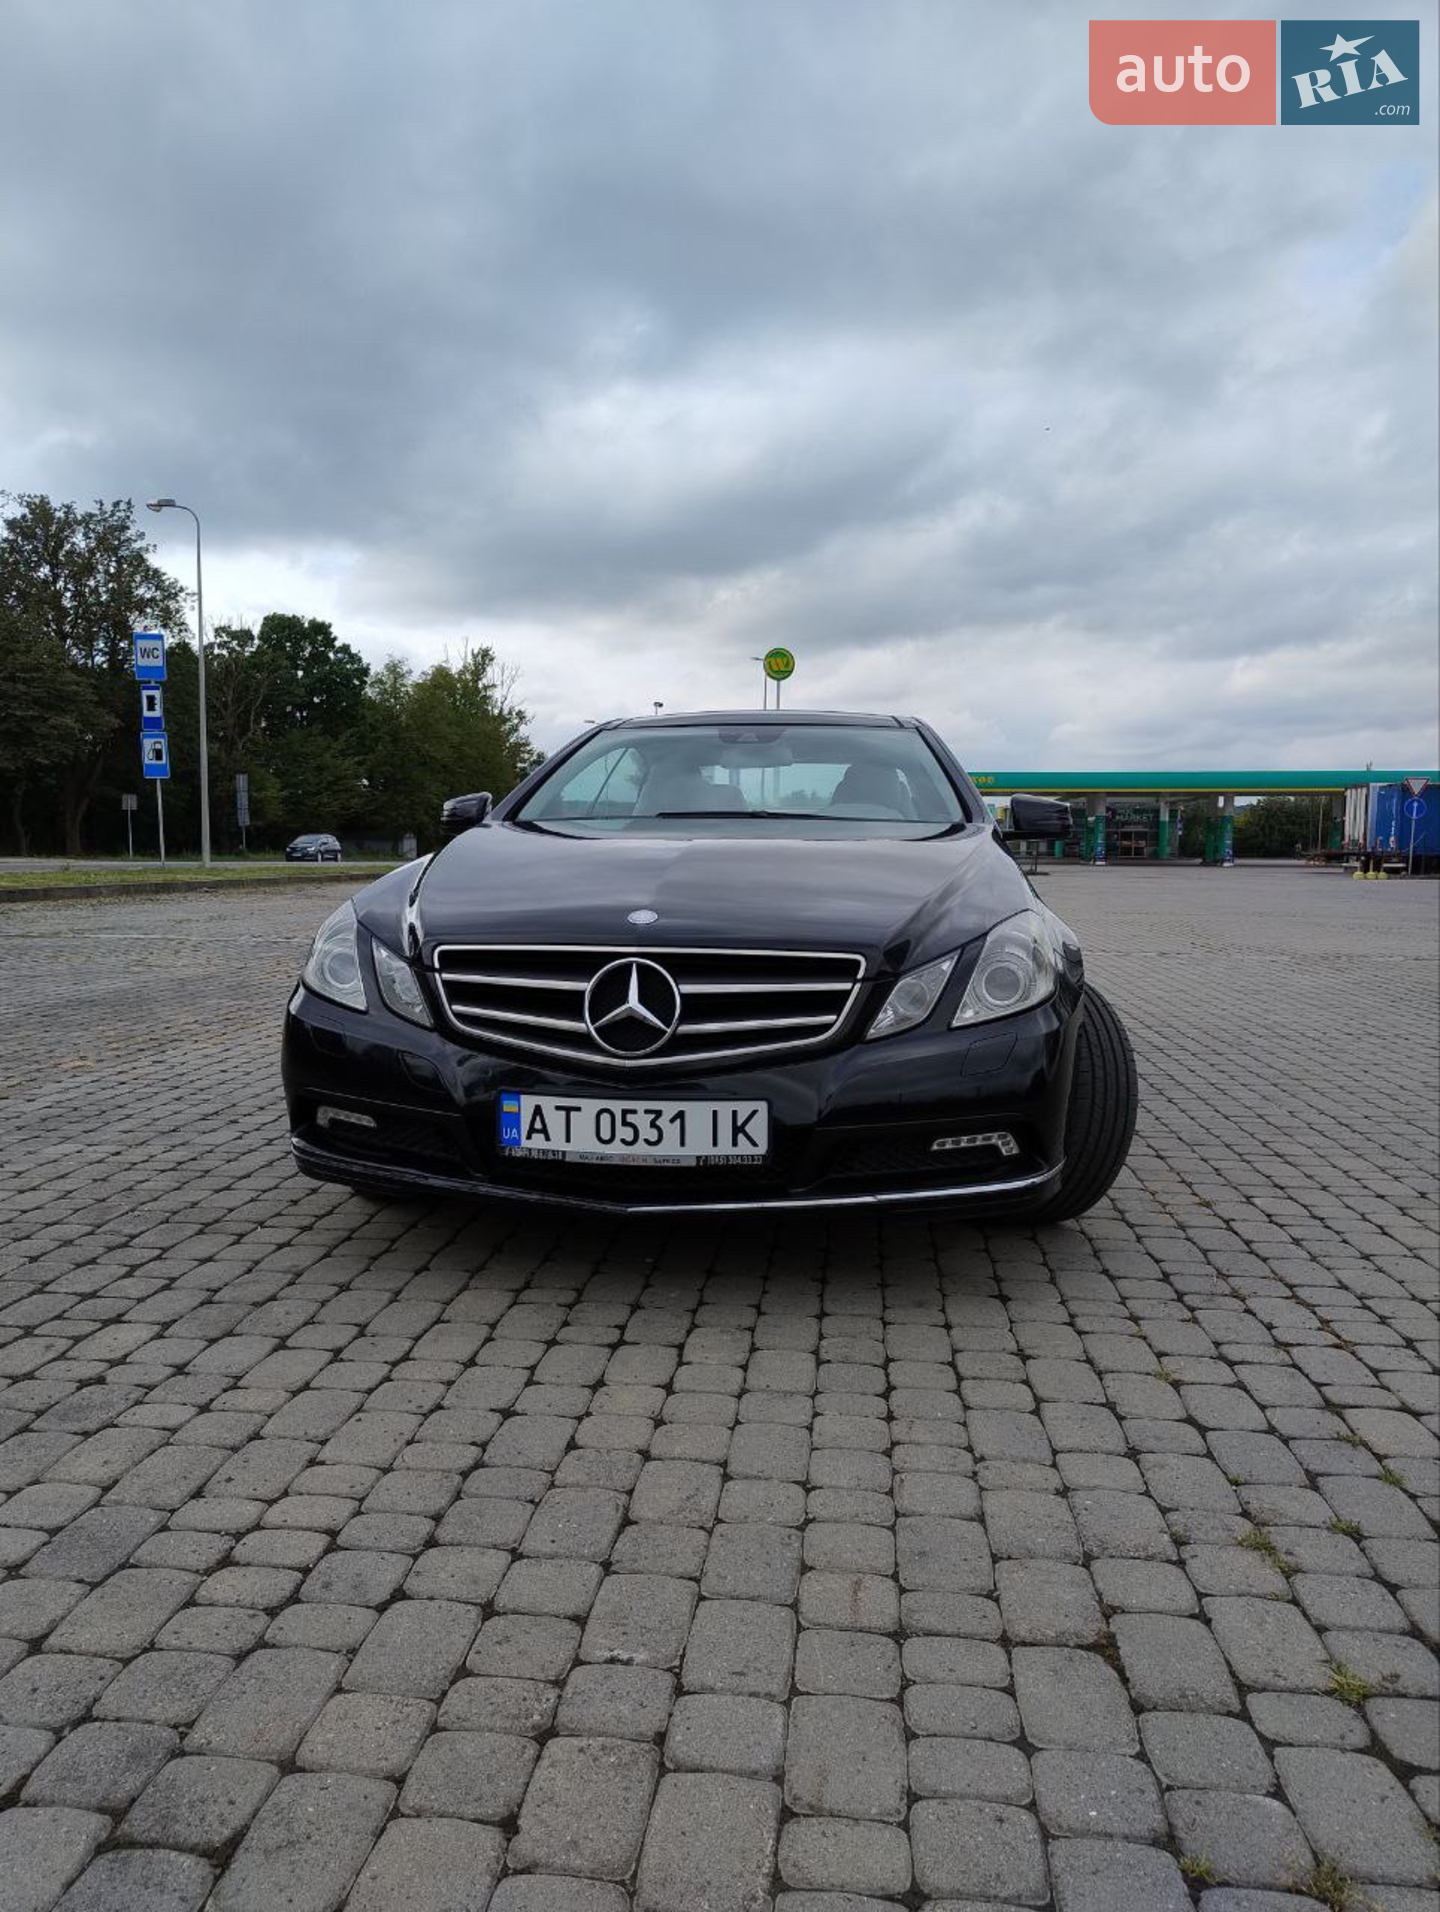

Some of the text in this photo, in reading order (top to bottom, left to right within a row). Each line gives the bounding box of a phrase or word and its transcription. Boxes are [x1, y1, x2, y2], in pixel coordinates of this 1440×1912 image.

[139, 647, 160, 659] WC
[525, 1104, 760, 1148] AT 0531 IK
[502, 1128, 519, 1140] UA
